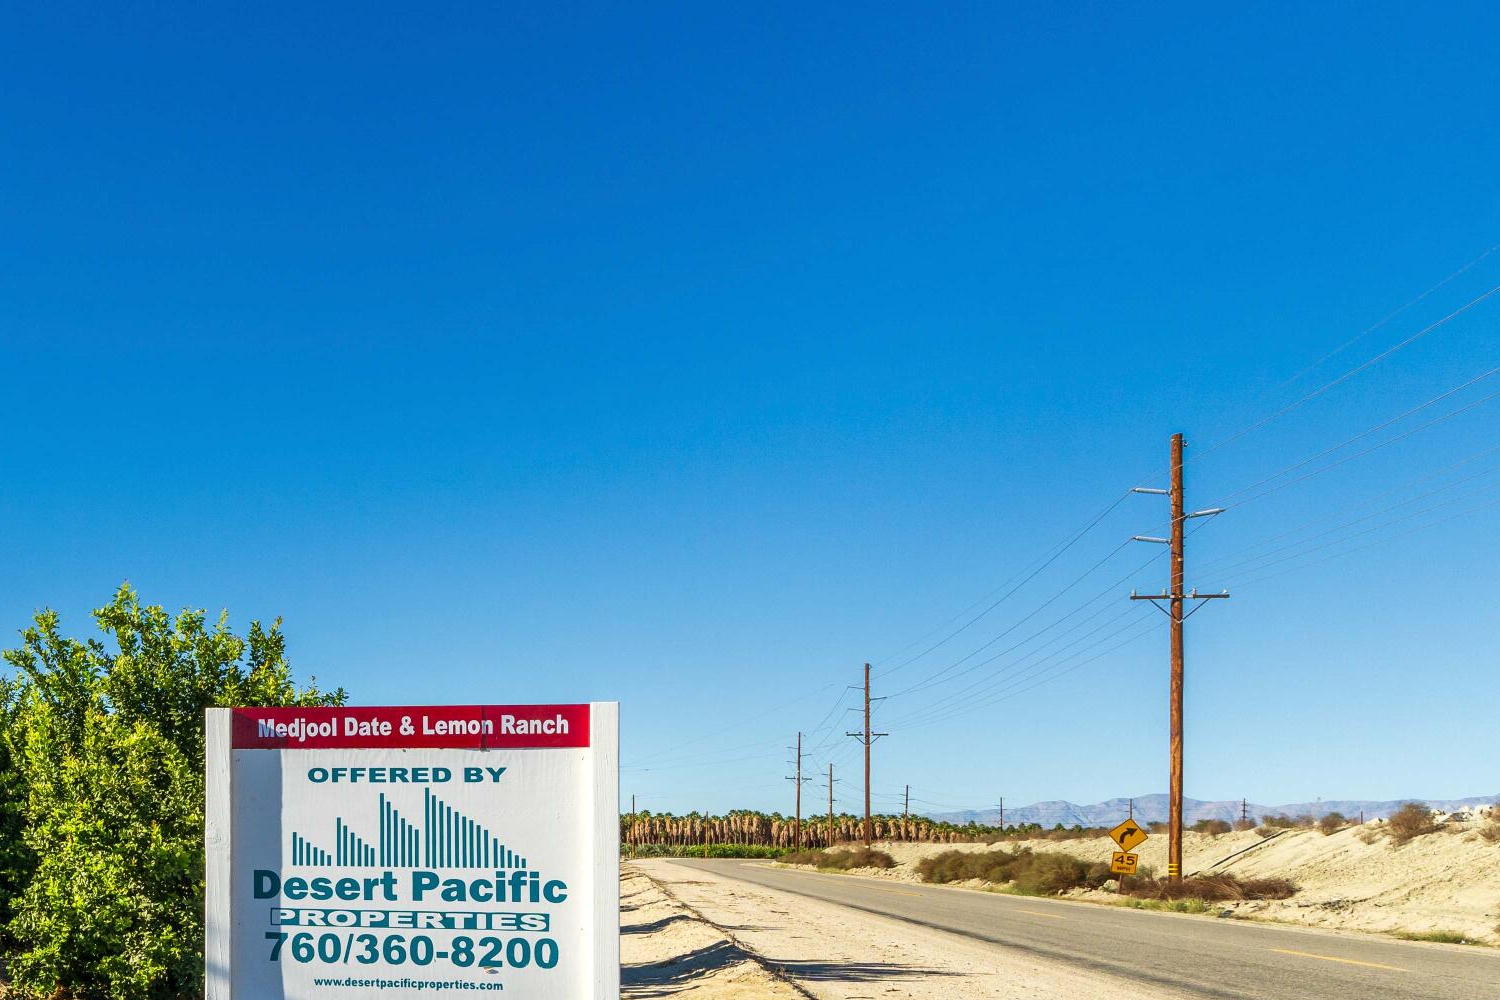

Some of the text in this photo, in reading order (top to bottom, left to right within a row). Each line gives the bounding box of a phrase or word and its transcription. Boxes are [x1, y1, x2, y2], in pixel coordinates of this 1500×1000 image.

[258, 714, 569, 742] Medjool Date & Lemon Ranch
[307, 767, 507, 783] OFFERED BY
[1115, 855, 1135, 866] 45
[253, 869, 568, 904] Desert Pacific
[278, 908, 547, 930] PROPERTIES
[264, 931, 560, 969] 760/360-8200
[314, 977, 503, 991] www.desertpacificproperties.com
